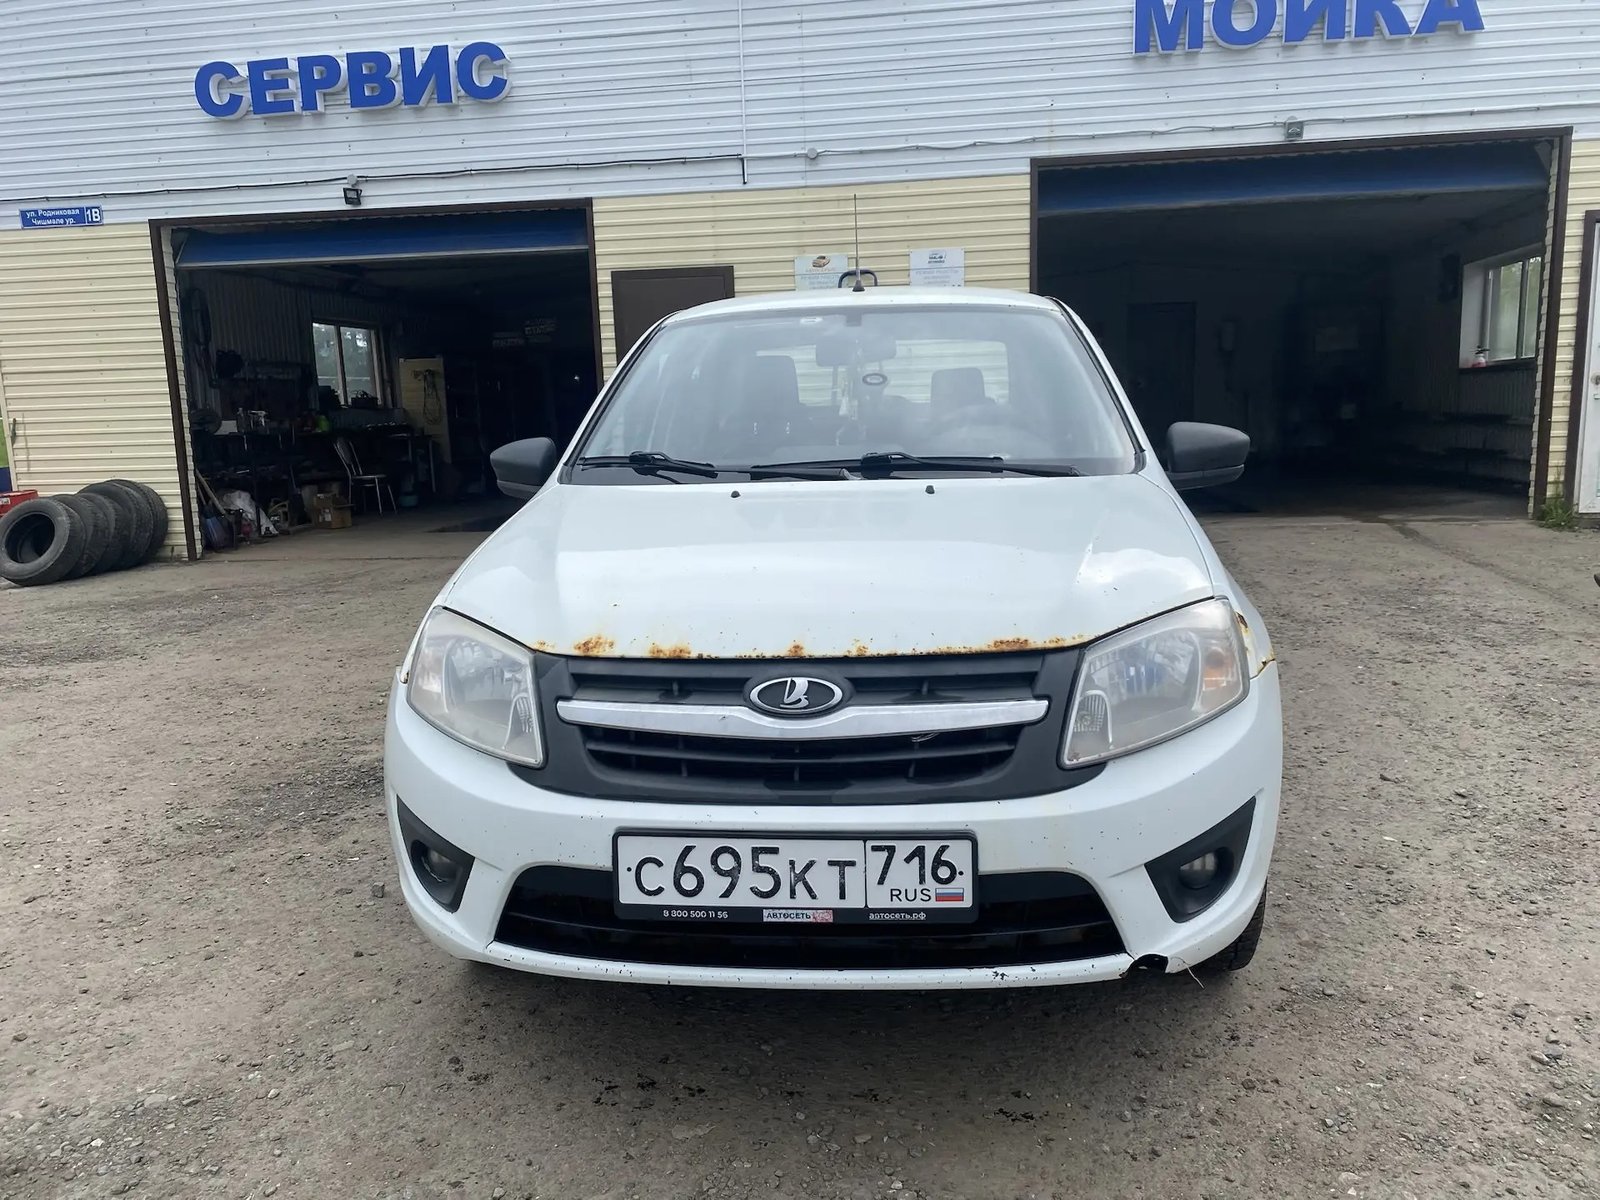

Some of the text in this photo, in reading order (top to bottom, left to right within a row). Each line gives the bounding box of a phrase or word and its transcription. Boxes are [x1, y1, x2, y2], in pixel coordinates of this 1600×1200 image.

[194, 41, 512, 119] СЕРВИС
[38, 208, 80, 217] Родниковая
[634, 844, 958, 900] С695КТ 716
[890, 888, 932, 902] RUS
[671, 909, 688, 918] 800
[690, 910, 706, 918] 500
[708, 910, 715, 918] 11
[717, 911, 728, 919] 56
[868, 911, 927, 921] автосеть.рф
